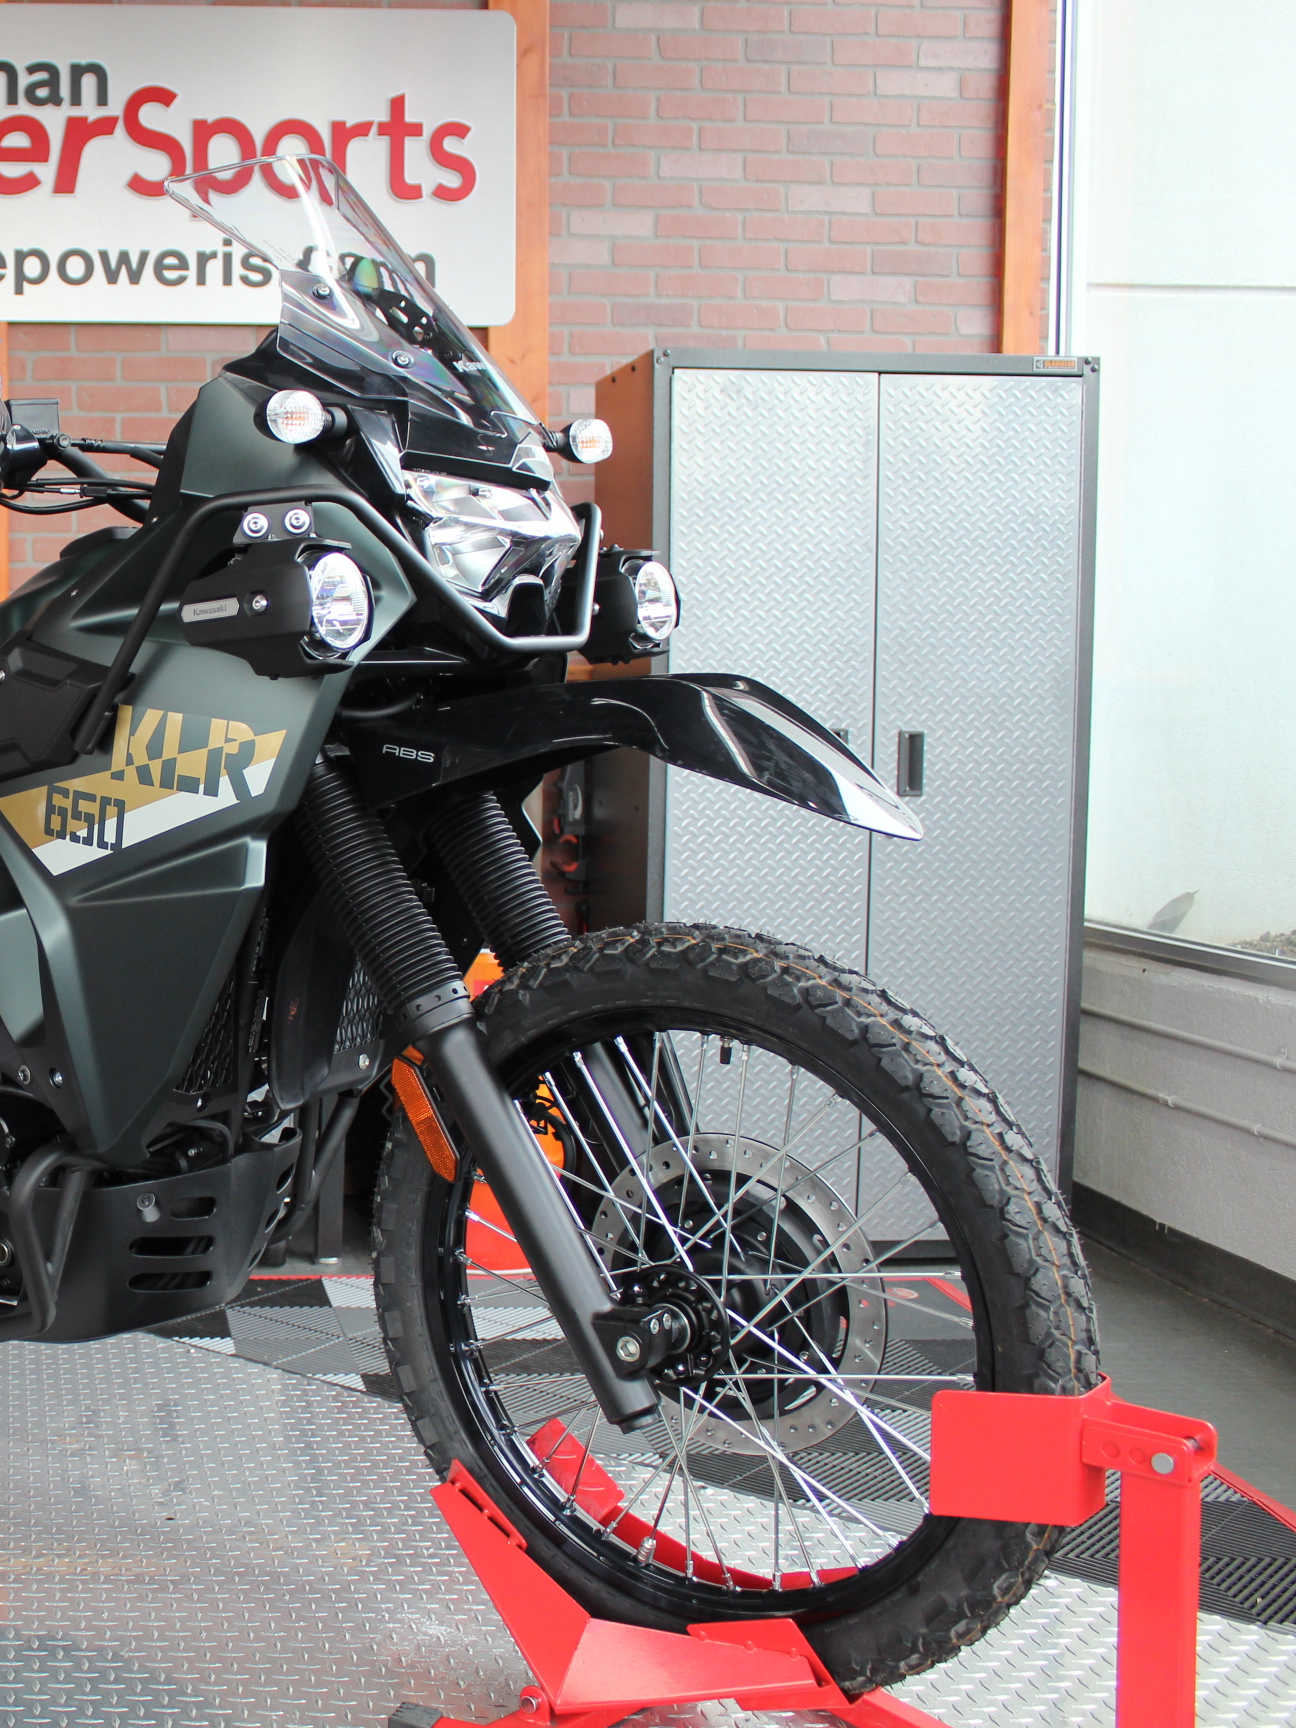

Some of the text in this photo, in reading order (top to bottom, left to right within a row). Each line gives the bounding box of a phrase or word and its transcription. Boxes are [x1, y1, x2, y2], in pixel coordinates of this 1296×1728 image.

[193, 604, 227, 616] Kawasaki
[110, 704, 256, 801] KLR
[382, 744, 435, 763] ABS
[44, 784, 126, 853] 650
